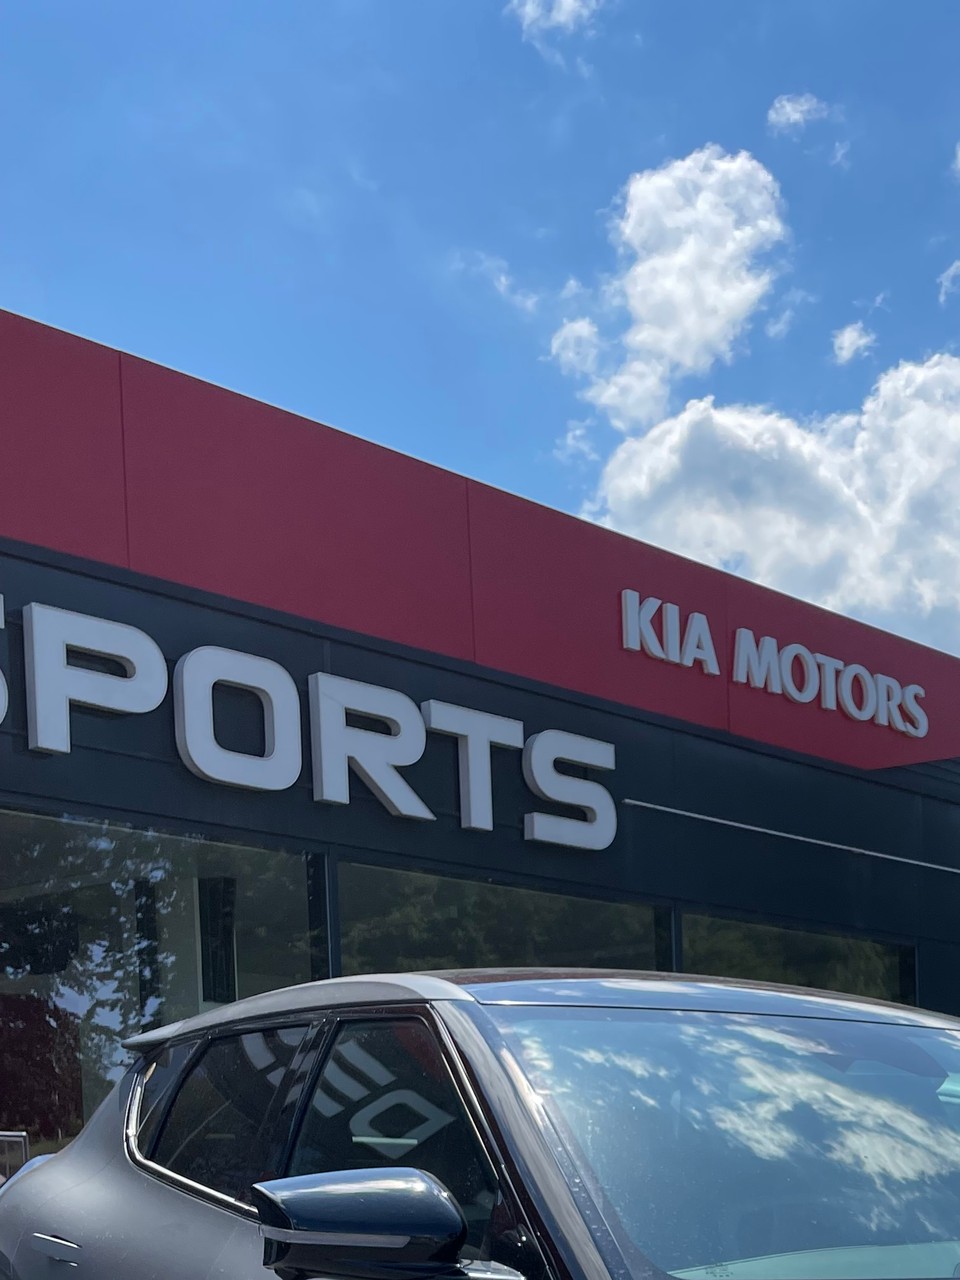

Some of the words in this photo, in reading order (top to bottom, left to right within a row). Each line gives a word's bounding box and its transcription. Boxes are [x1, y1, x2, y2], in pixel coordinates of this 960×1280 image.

[0, 594, 619, 851] PORTS
[621, 588, 720, 676] KIA
[733, 627, 929, 738] MOTORS
